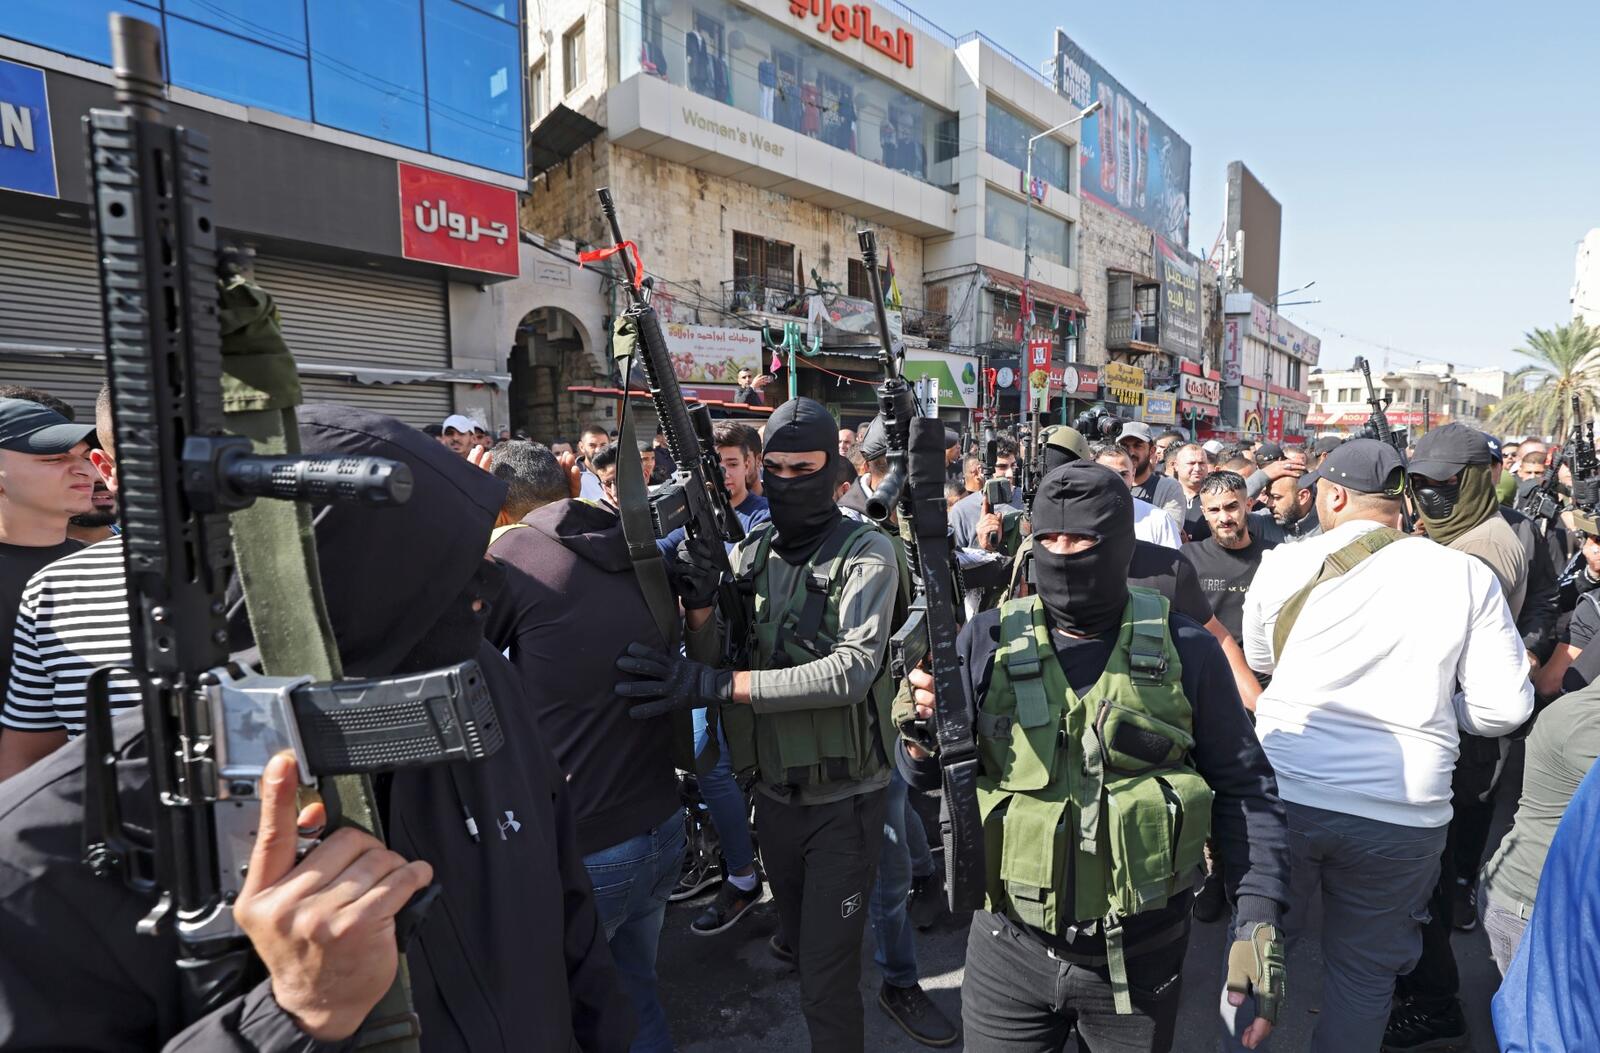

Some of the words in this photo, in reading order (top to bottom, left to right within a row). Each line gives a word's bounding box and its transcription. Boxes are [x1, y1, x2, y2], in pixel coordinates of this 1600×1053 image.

[1063, 54, 1091, 91] POWER
[1063, 74, 1091, 107] HORSE
[682, 106, 748, 145] Women's
[749, 131, 785, 157] Wear
[415, 199, 509, 245] جروان
[1110, 388, 1137, 399] WESTERN
[1120, 395, 1139, 406] UNION
